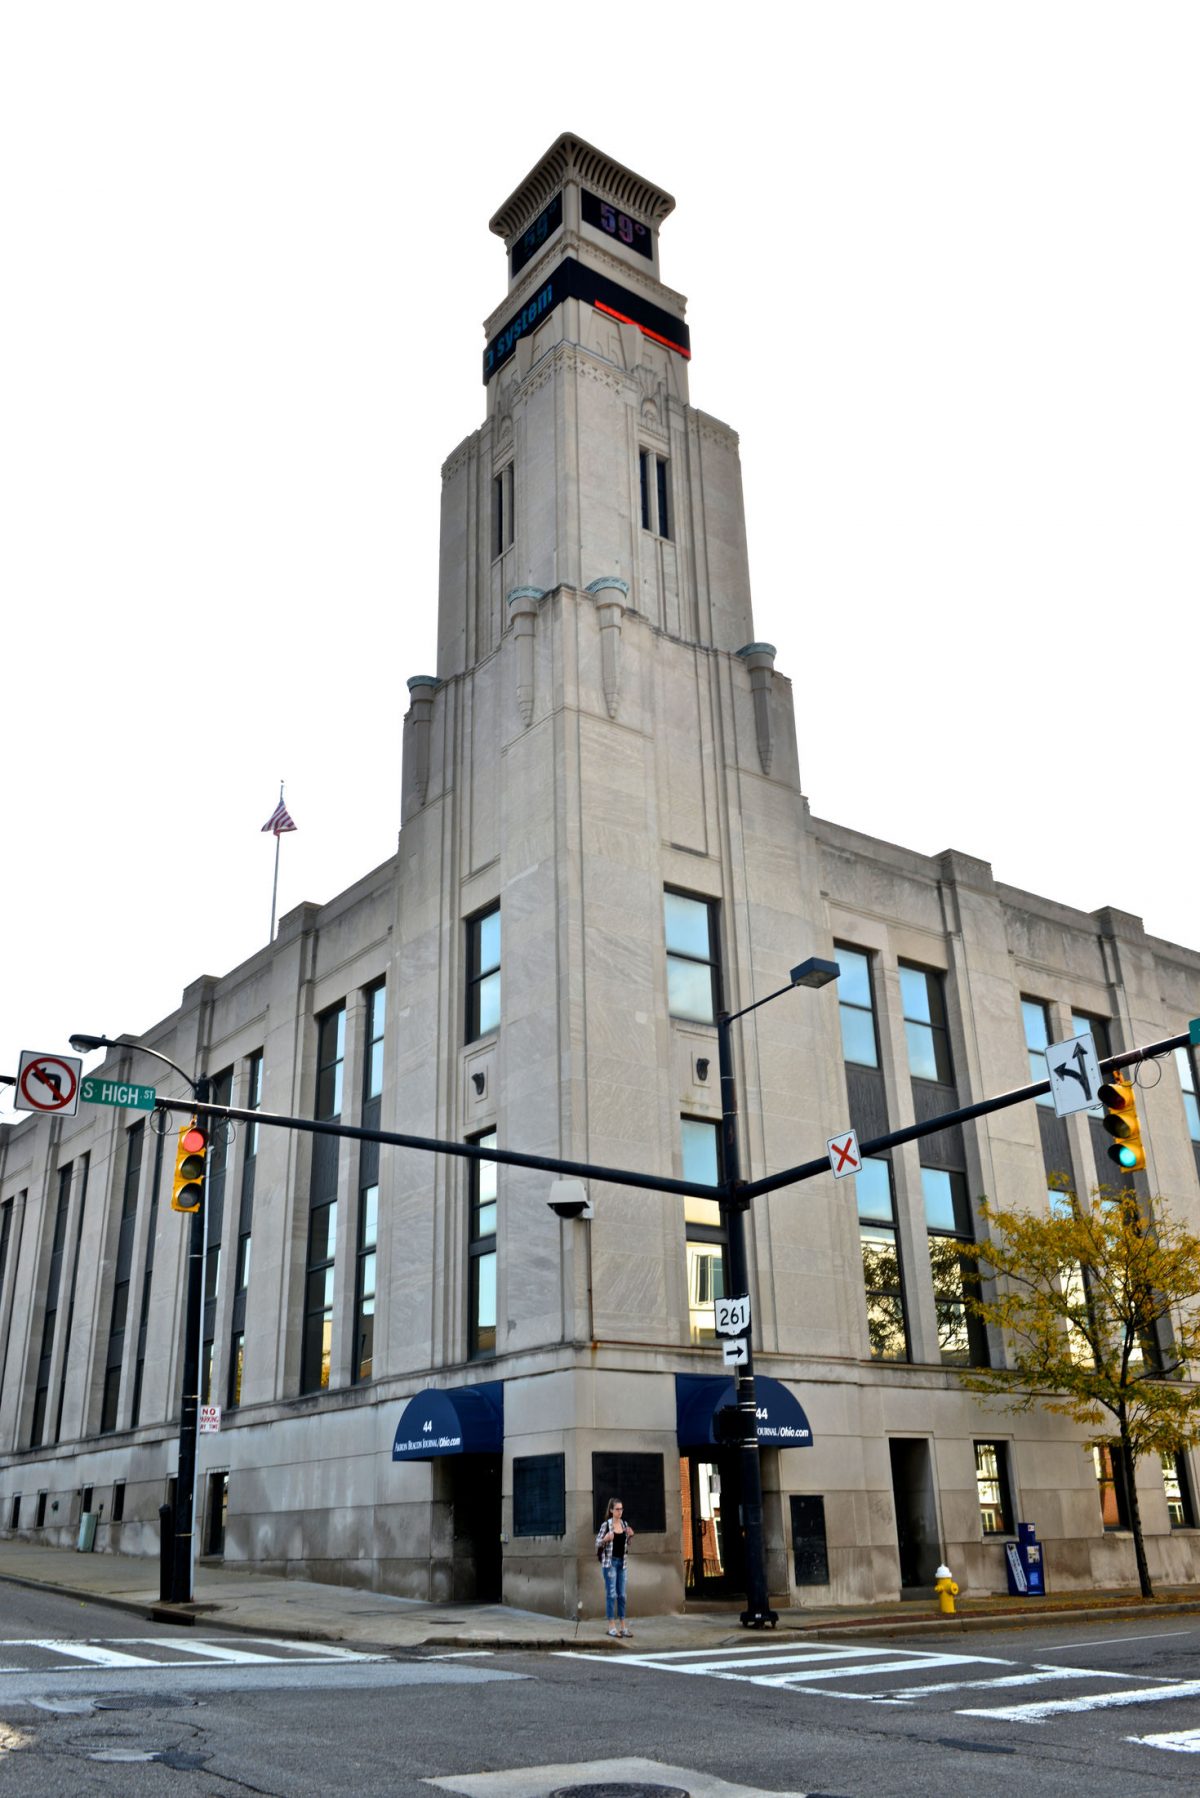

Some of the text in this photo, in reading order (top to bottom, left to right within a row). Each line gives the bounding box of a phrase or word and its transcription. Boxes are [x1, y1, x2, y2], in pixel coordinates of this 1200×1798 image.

[496, 283, 553, 358] system
[83, 1081, 154, 1105] S HIGH ST
[719, 1305, 745, 1327] 261
[755, 1407, 768, 1420] 44
[422, 1419, 432, 1433] 44
